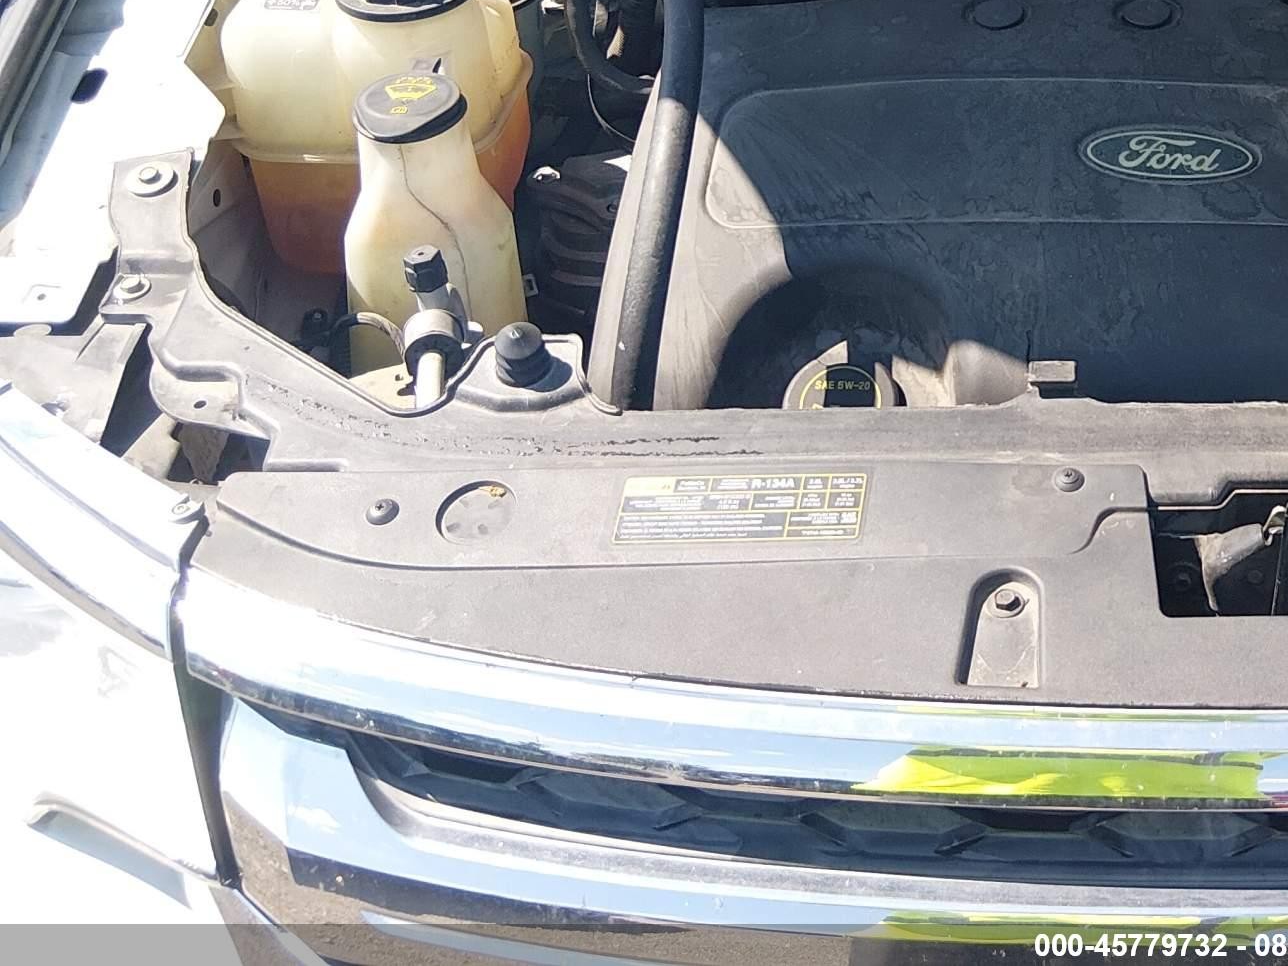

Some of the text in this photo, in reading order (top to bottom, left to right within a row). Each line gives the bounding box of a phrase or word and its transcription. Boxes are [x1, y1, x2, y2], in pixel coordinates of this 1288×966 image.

[1118, 136, 1222, 172] Ford
[815, 380, 871, 390] SAE 5W-20
[751, 478, 795, 489] R-134A
